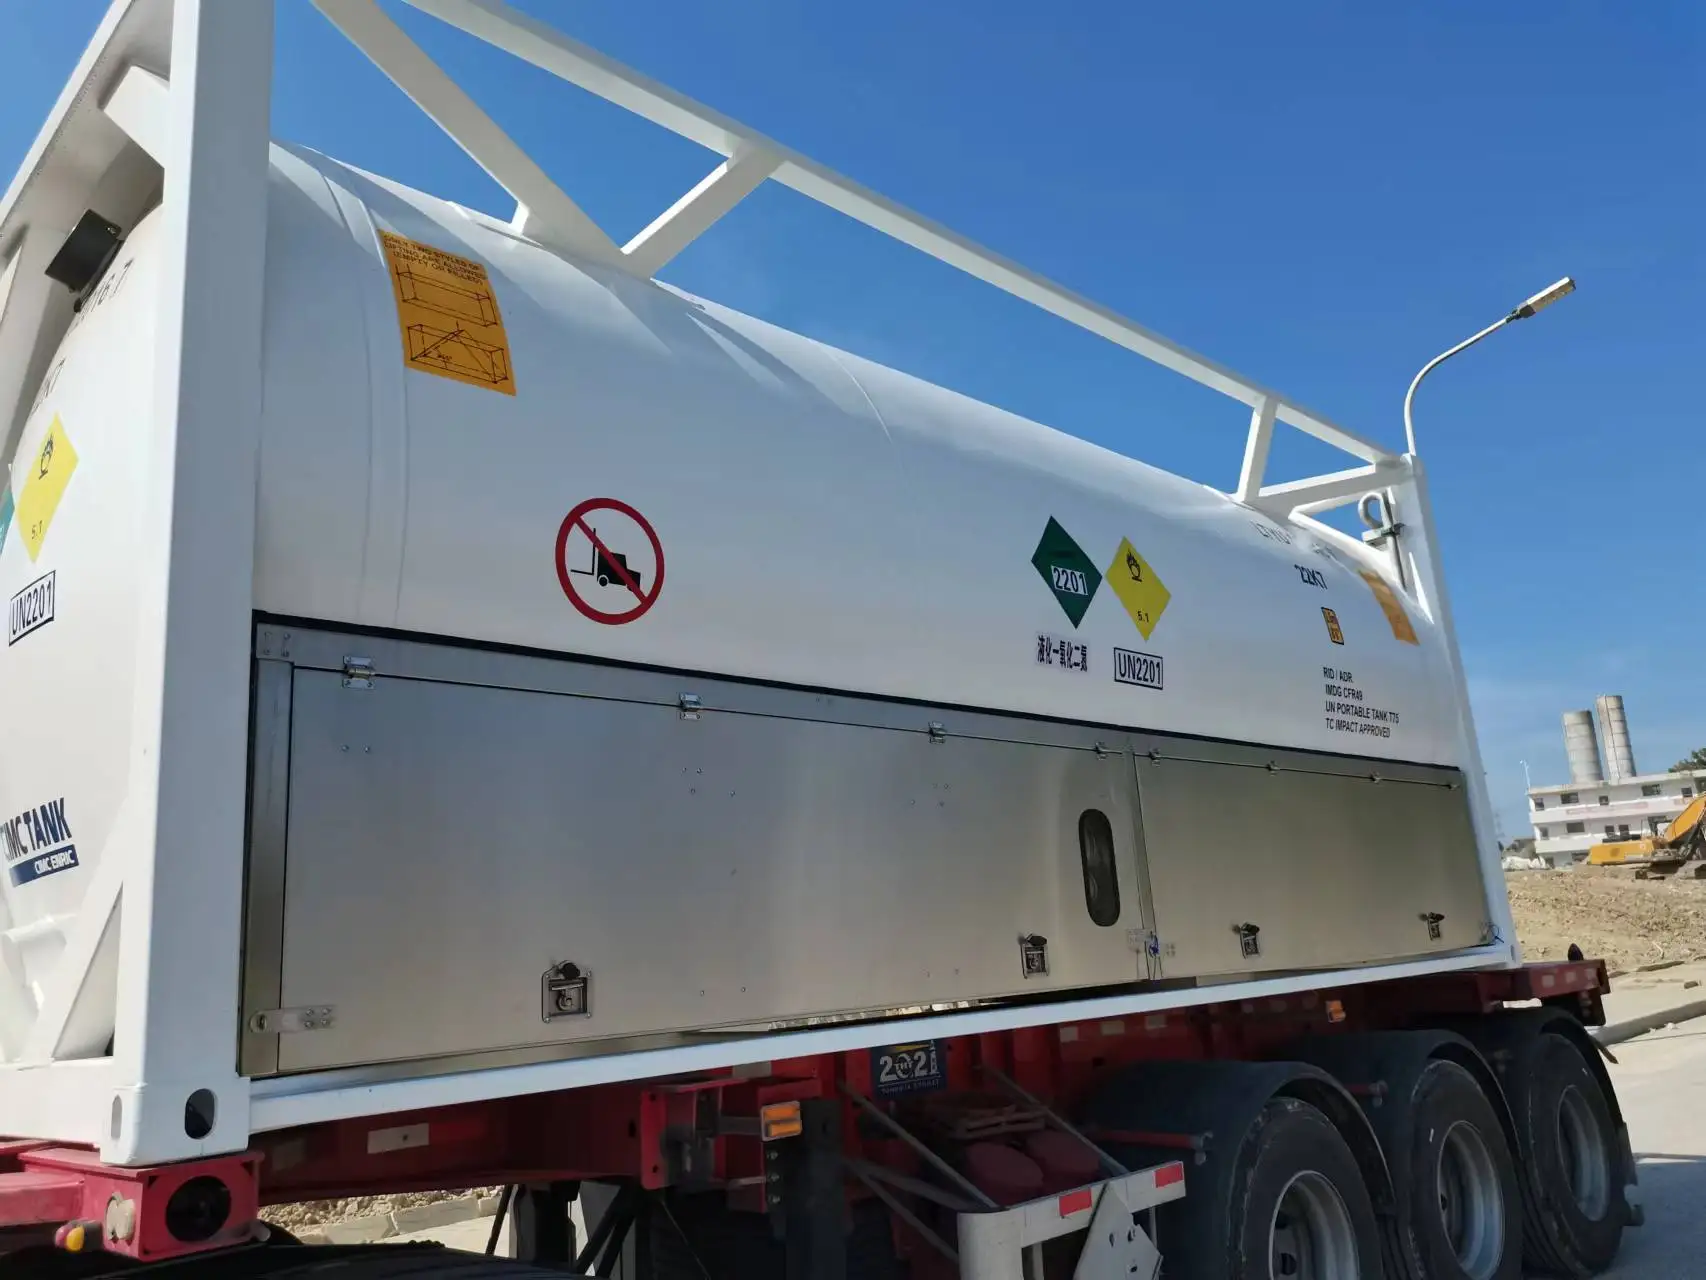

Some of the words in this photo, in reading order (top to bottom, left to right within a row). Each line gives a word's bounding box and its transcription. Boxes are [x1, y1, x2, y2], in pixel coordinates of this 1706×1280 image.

[1053, 567, 1087, 594] 2201
[12, 580, 52, 635] UN2201
[1137, 610, 1150, 623] 5.1
[1118, 652, 1161, 685] UN2201
[1323, 667, 1335, 679] RID
[1325, 684, 1342, 697] IMDG
[1343, 687, 1363, 701] CFR49
[1325, 700, 1335, 713] UN
[1336, 702, 1370, 719] PORTABLE
[1371, 708, 1388, 722] TANK
[1389, 711, 1400, 724] T75
[1325, 717, 1334, 730] TC
[1335, 719, 1358, 733] IMPACT
[1359, 723, 1391, 738] APPROVED
